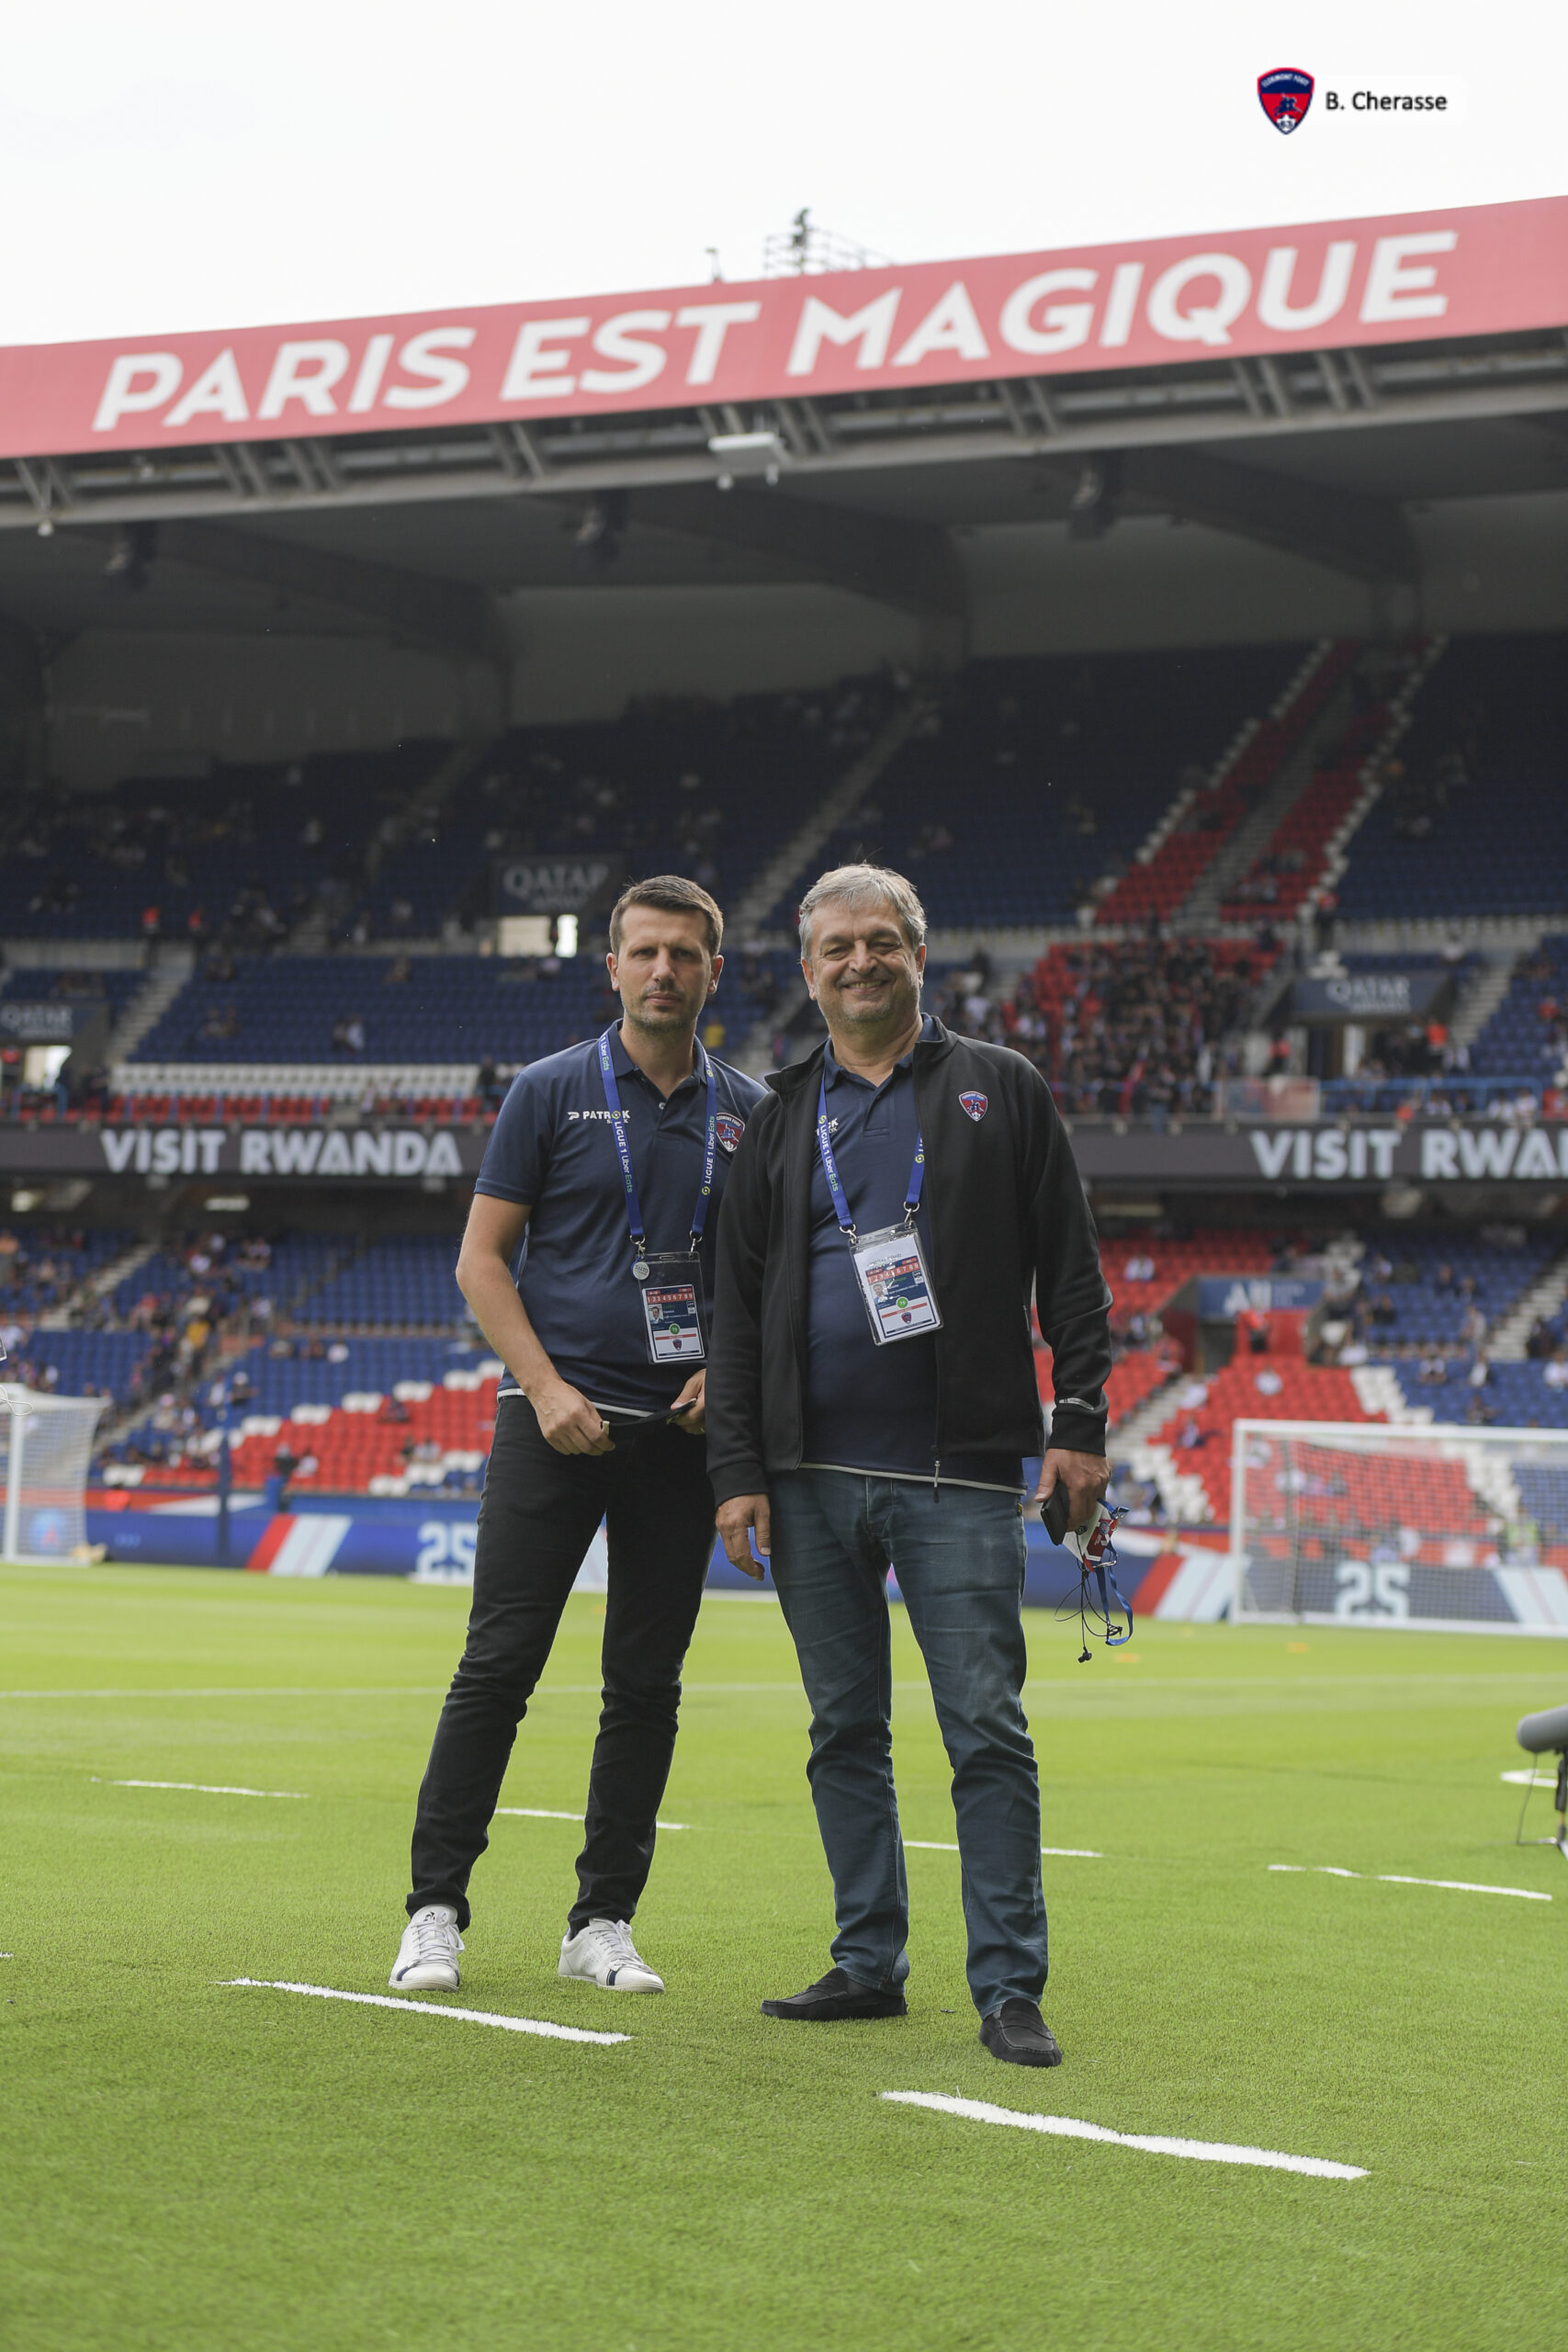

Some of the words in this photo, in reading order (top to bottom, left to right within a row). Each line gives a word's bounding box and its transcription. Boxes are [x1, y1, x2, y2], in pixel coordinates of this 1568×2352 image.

[92, 327, 478, 432] PARIS
[499, 300, 761, 401] EST
[787, 231, 1458, 376] MAGIQUE
[614, 1121, 626, 1148] LIGUE
[819, 1124, 829, 1149] LIGUE
[100, 1128, 226, 1175] VISIT
[240, 1128, 462, 1176] RWANDA
[621, 1155, 630, 1174] Uber
[825, 1156, 834, 1174] Uber
[1250, 1129, 1402, 1180] VISIT
[1421, 1129, 1568, 1180] RWA
[625, 1173, 633, 1193] Eats
[704, 1157, 714, 1184] LIGUE
[829, 1173, 839, 1192] Eats
[1336, 1562, 1410, 1623] 25
